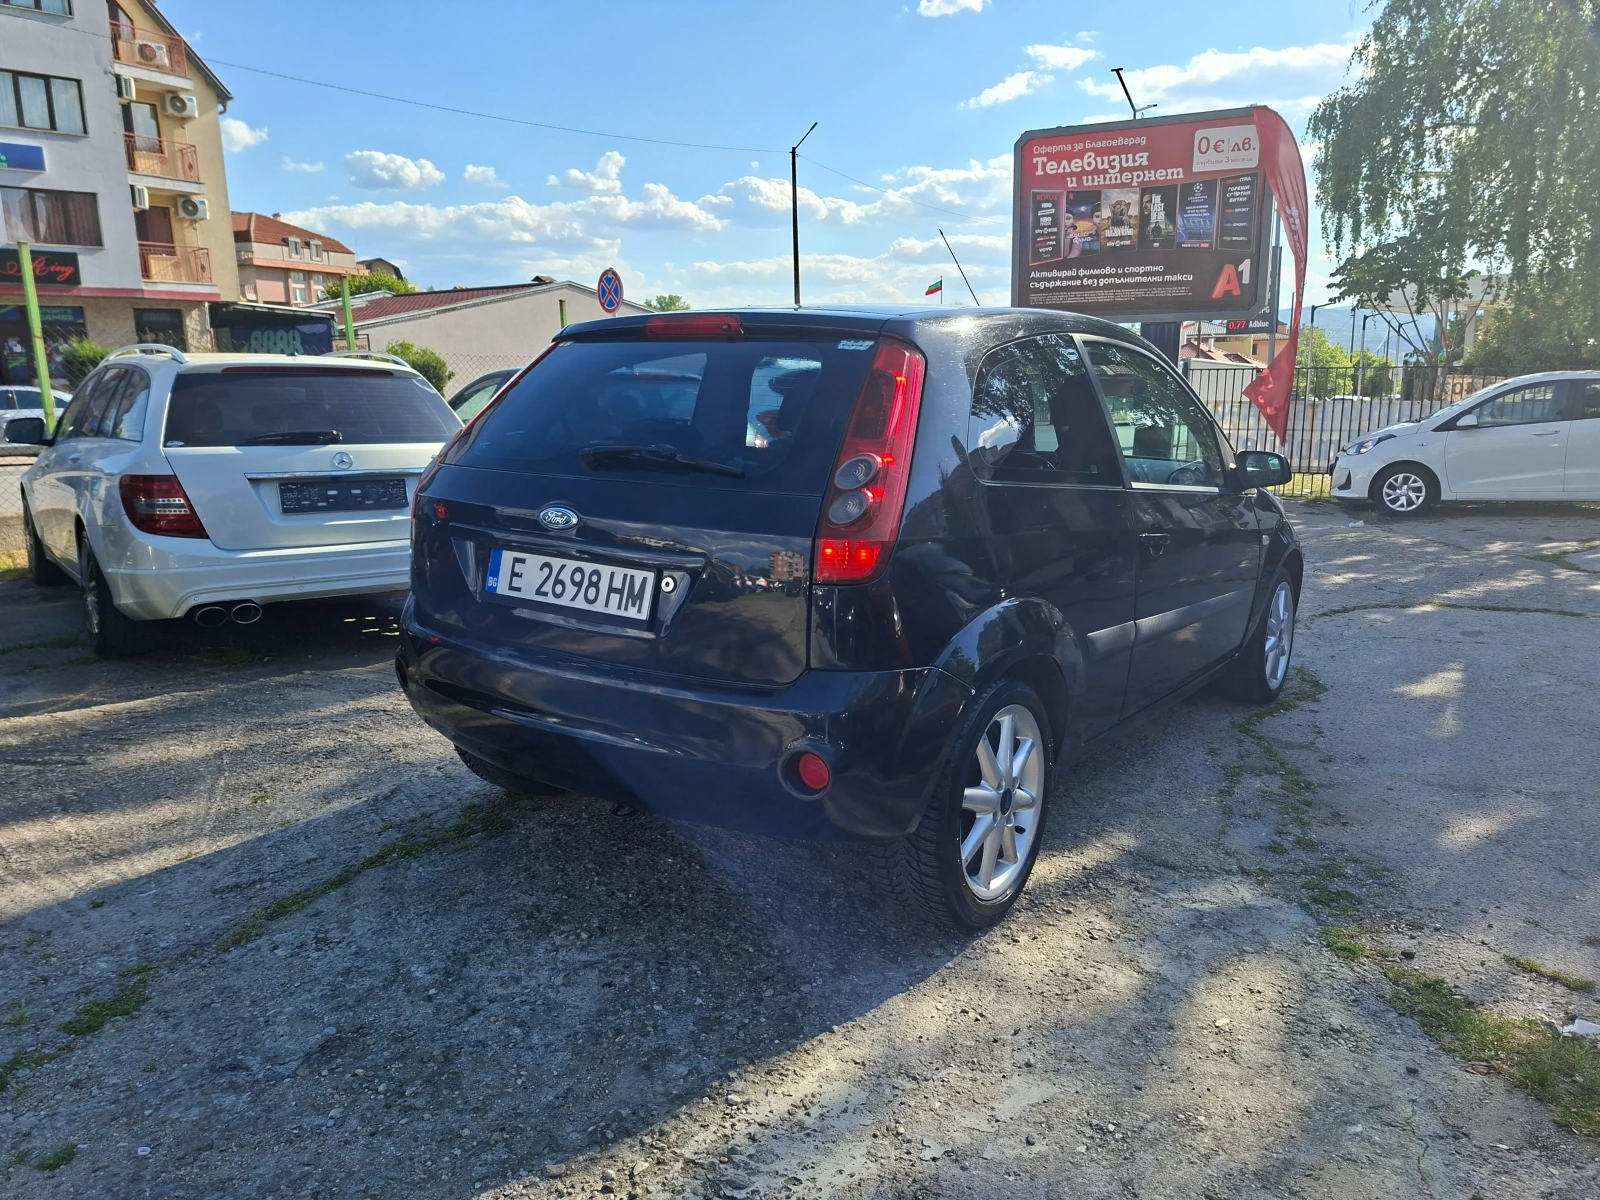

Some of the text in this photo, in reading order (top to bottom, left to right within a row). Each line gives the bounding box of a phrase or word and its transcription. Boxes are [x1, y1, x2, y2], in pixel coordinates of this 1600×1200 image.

[1033, 136, 1146, 155] Оферта за Благоевград
[1197, 135, 1256, 155] 0 € лв.
[1033, 151, 1149, 175] Телевизия
[1066, 167, 1184, 188] и интернет
[1151, 194, 1162, 204] THE
[1150, 203, 1164, 212] LAST
[1150, 211, 1165, 220] OF US
[1030, 268, 1077, 279] Активирай
[1078, 266, 1116, 277] филмово
[1124, 265, 1164, 274] спортно
[1211, 258, 1251, 299] A1
[1029, 273, 1193, 290] съдържание без допълнителни такси
[1228, 320, 1270, 330] 0.77 Adblue
[544, 510, 568, 525] Ford
[487, 576, 498, 587] BG
[508, 556, 648, 614] E 2698 HM
